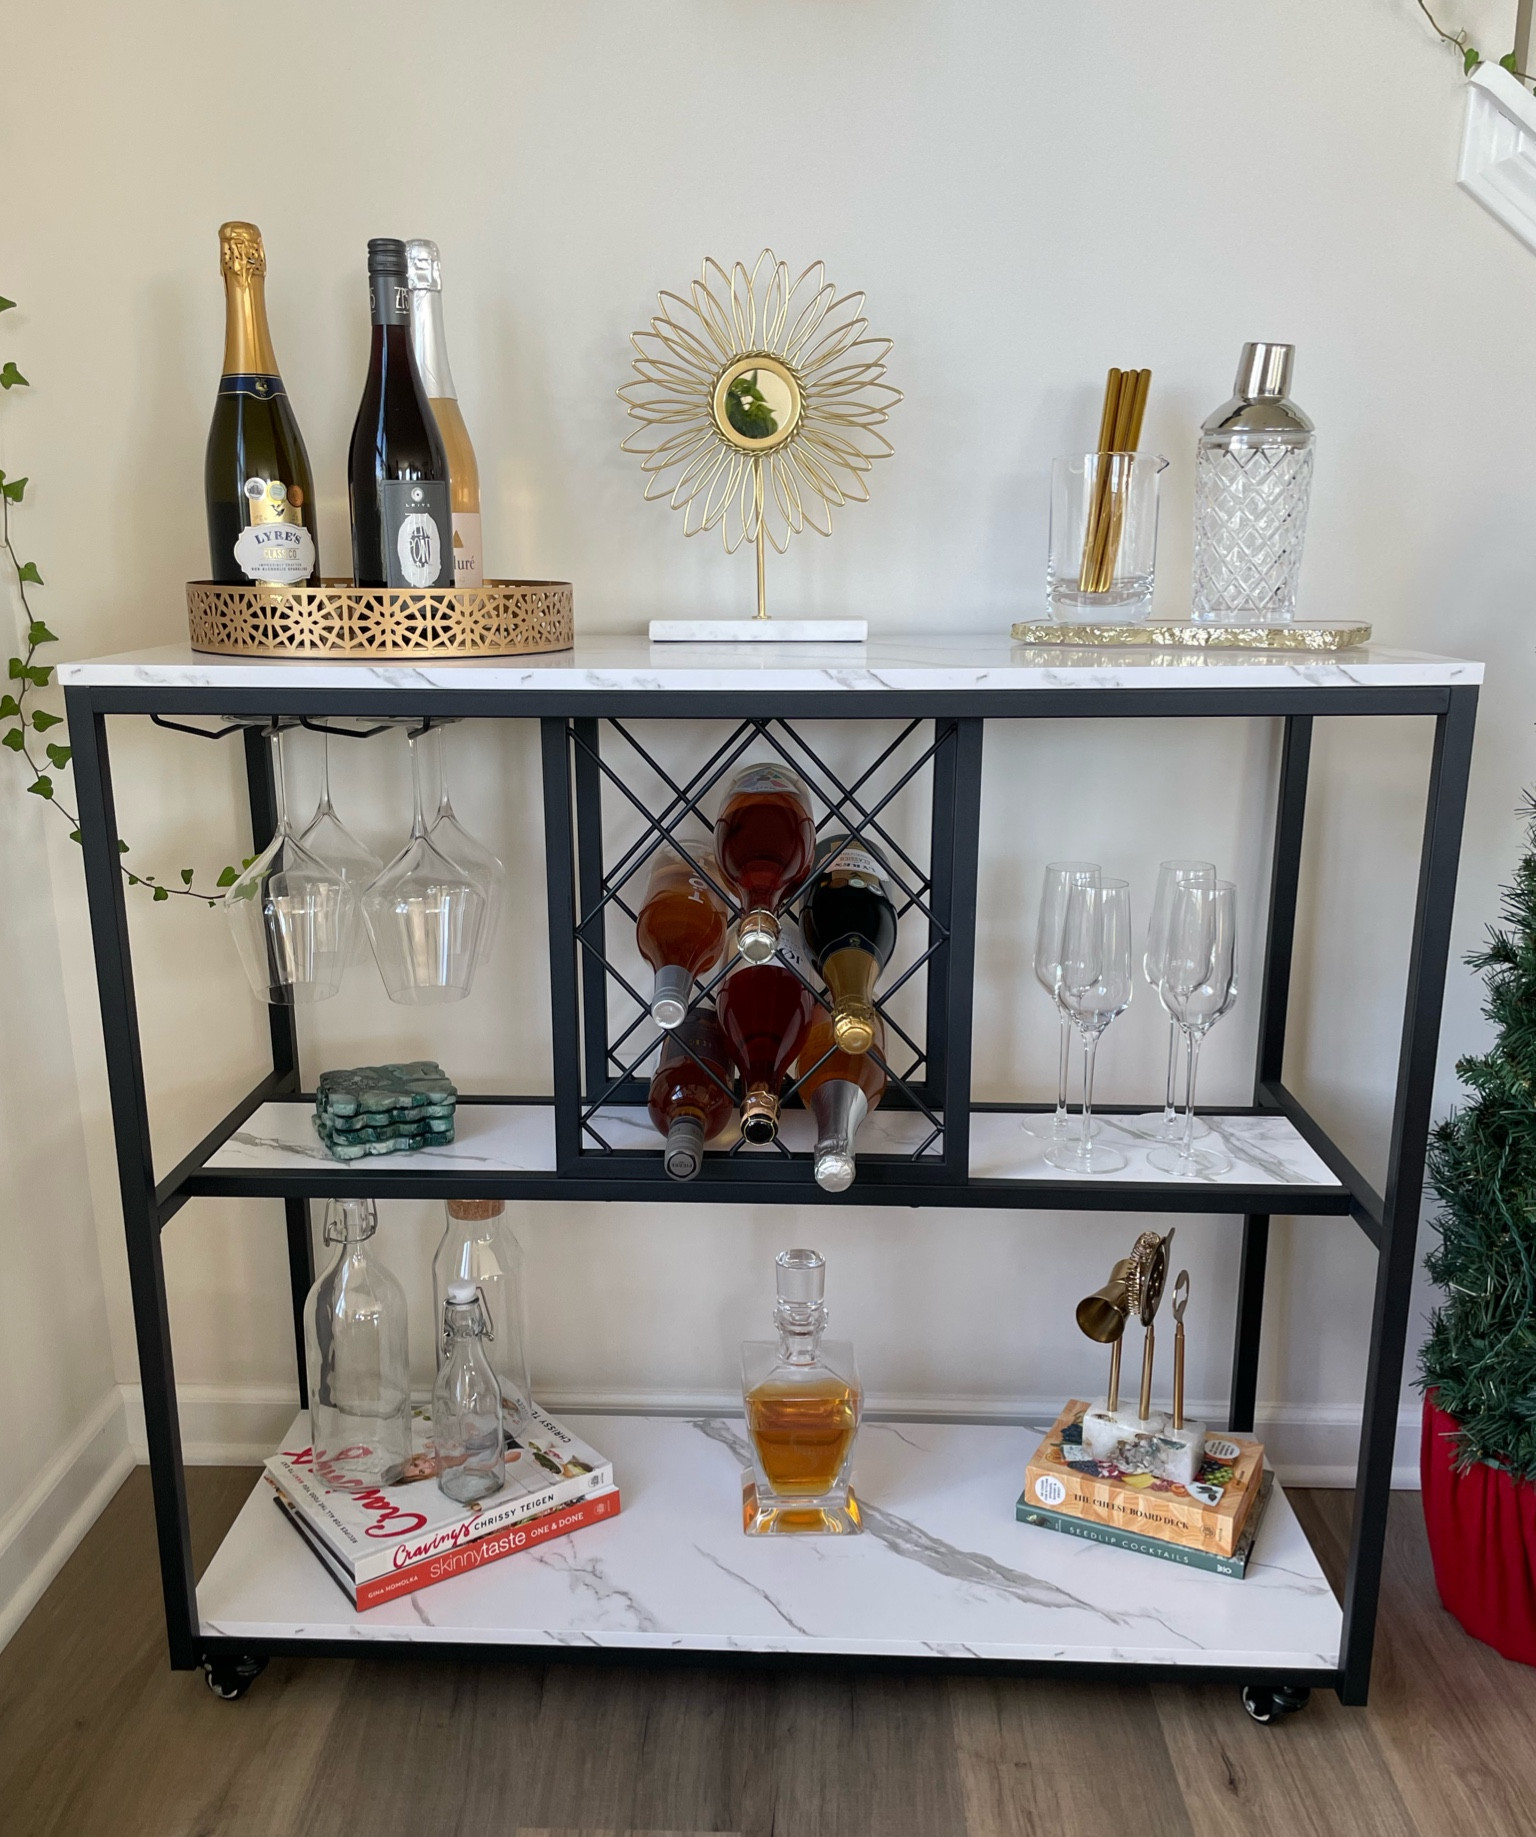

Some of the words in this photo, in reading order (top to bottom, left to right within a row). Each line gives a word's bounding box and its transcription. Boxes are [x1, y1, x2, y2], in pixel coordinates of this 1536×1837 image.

[254, 530, 302, 545] LYRE'S
[263, 549, 298, 559] CLASSCO
[539, 1420, 571, 1444] CHRISSY
[1074, 1493, 1089, 1504] THE
[1092, 1498, 1127, 1513] CHEESE
[1129, 1507, 1162, 1522] BOARD
[1163, 1517, 1190, 1530] DECK
[393, 1513, 484, 1569] Cravings
[474, 1508, 516, 1531] CHRISSY
[520, 1493, 555, 1512] TEIGEN
[1069, 1526, 1117, 1544] SEEDLIP
[1121, 1540, 1190, 1564] COCKTAILS
[368, 1588, 385, 1599] GINA
[385, 1575, 419, 1592] HOMOLKA
[430, 1531, 527, 1578] skinnytaste
[530, 1525, 549, 1538] ONE
[551, 1521, 558, 1530] &
[559, 1511, 584, 1528] DONE
